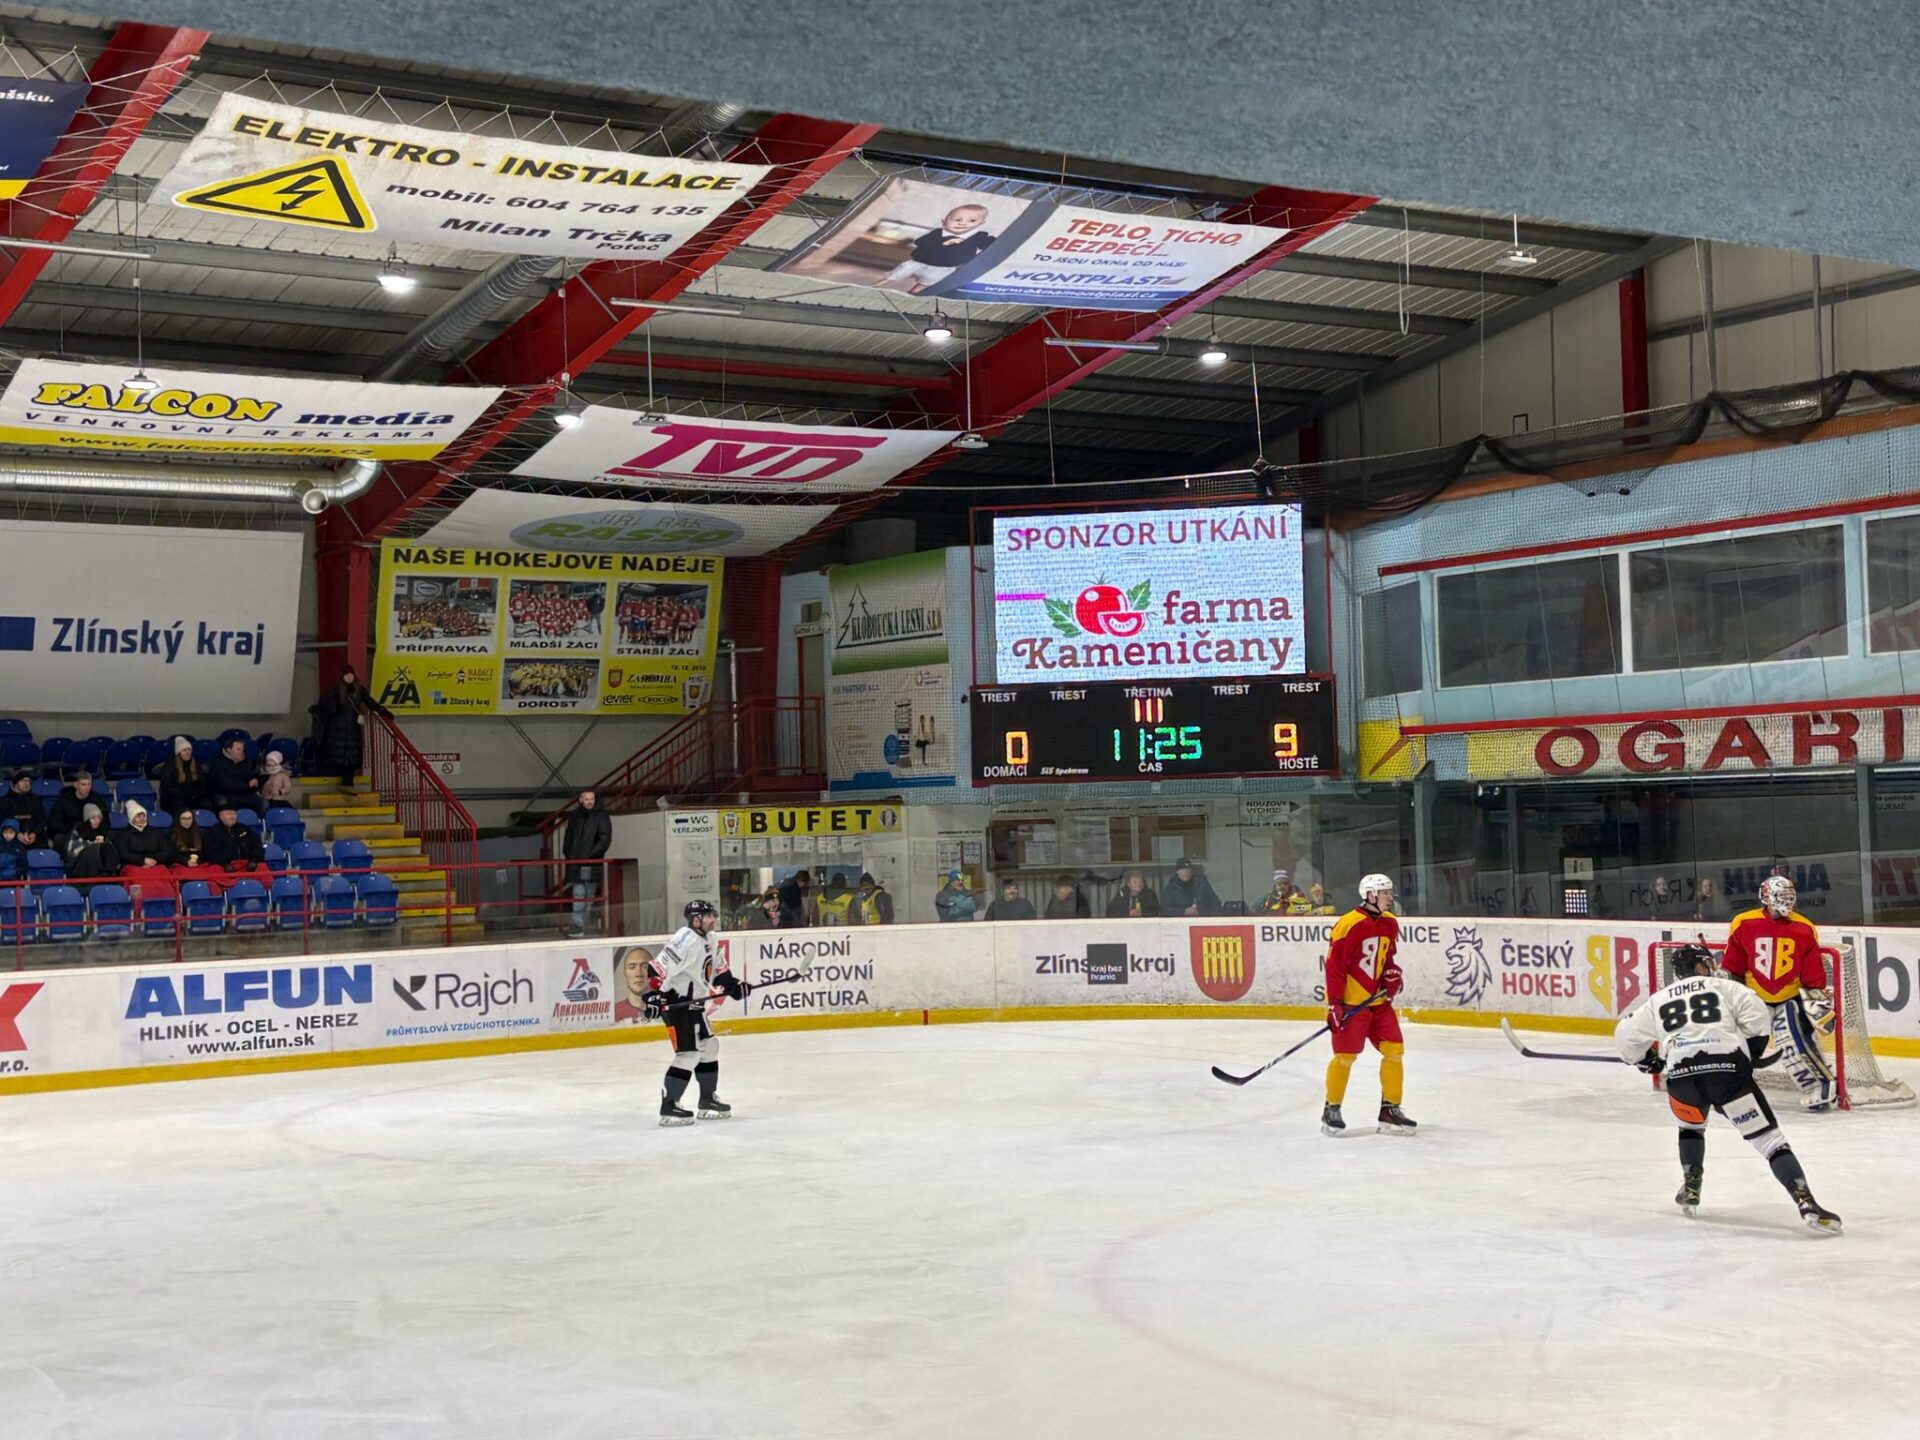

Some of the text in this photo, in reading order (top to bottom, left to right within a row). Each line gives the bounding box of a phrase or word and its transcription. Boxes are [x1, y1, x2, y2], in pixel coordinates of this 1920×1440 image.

[232, 114, 461, 166] ELEKTRO
[499, 157, 742, 191] INSTALACE
[385, 184, 708, 217] mobil: 604 764 135
[440, 218, 674, 243] Milan Trčka
[1066, 218, 1243, 246] TEPLO, TICHO,
[1003, 271, 1169, 286] MONTPLAST
[31, 382, 454, 426] FALCON media
[25, 412, 436, 438] VENKOVNÍ REKLAMA
[58, 436, 373, 456] www.falconmedia.cz
[605, 423, 888, 483] TVD
[1007, 507, 1289, 551] SPONZOR UTKÁNÍ
[1162, 590, 1293, 626] farma
[51, 617, 265, 665] Zlínský kraj
[1012, 630, 1294, 671] Kameničany
[981, 692, 1017, 703] TREST
[1050, 690, 1087, 701] TREST
[1124, 686, 1174, 698] TŘETINA
[1212, 684, 1250, 696] TREST
[1282, 682, 1321, 693] TREST
[1005, 731, 1029, 765] 0
[1273, 723, 1298, 758] 9
[1138, 761, 1163, 773] ČAS
[1279, 754, 1319, 770] HOSTÉ
[690, 816, 709, 824] WC
[749, 809, 873, 834] BUFET
[759, 934, 852, 960] NÁRODNÍ
[1501, 938, 1575, 968] ČESKÝ
[760, 957, 875, 983] SPORTOVNÍ
[1130, 953, 1175, 976] kraj
[125, 963, 373, 1020] ALFUN
[434, 968, 534, 1016] Rajch
[1502, 971, 1576, 998] HOKEJ
[1668, 980, 1706, 998] TOMEK
[761, 991, 870, 1011] AGENTURA
[1658, 992, 1722, 1033] 88
[140, 1018, 208, 1042] HLINÍK
[228, 1019, 278, 1036] OCEL
[296, 1012, 359, 1031] NEREZ
[386, 1017, 541, 1037] PRŮMYSLOVÁ VZDUCHOTECHNIKA
[187, 1032, 316, 1055] www.alfun.sk
